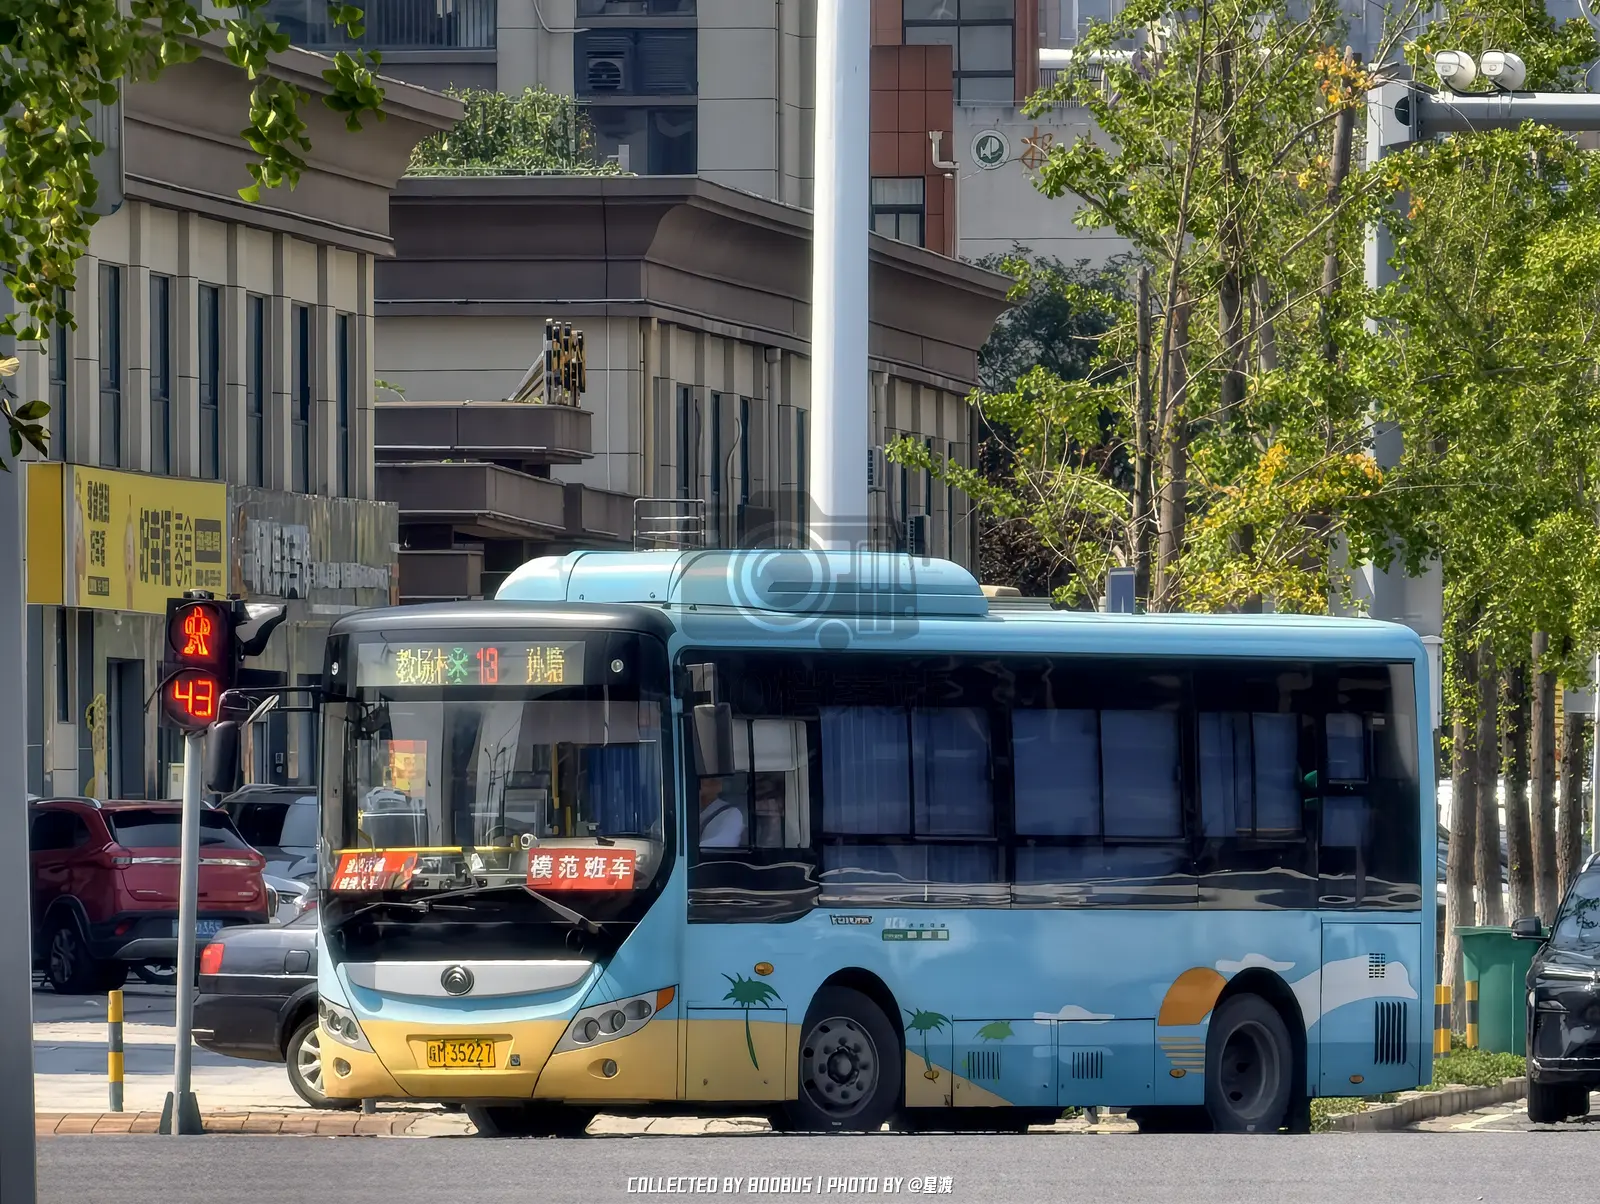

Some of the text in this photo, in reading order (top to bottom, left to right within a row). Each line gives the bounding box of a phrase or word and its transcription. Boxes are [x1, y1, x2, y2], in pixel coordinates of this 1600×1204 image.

[173, 680, 213, 717] 43
[530, 854, 632, 880] 模范班车
